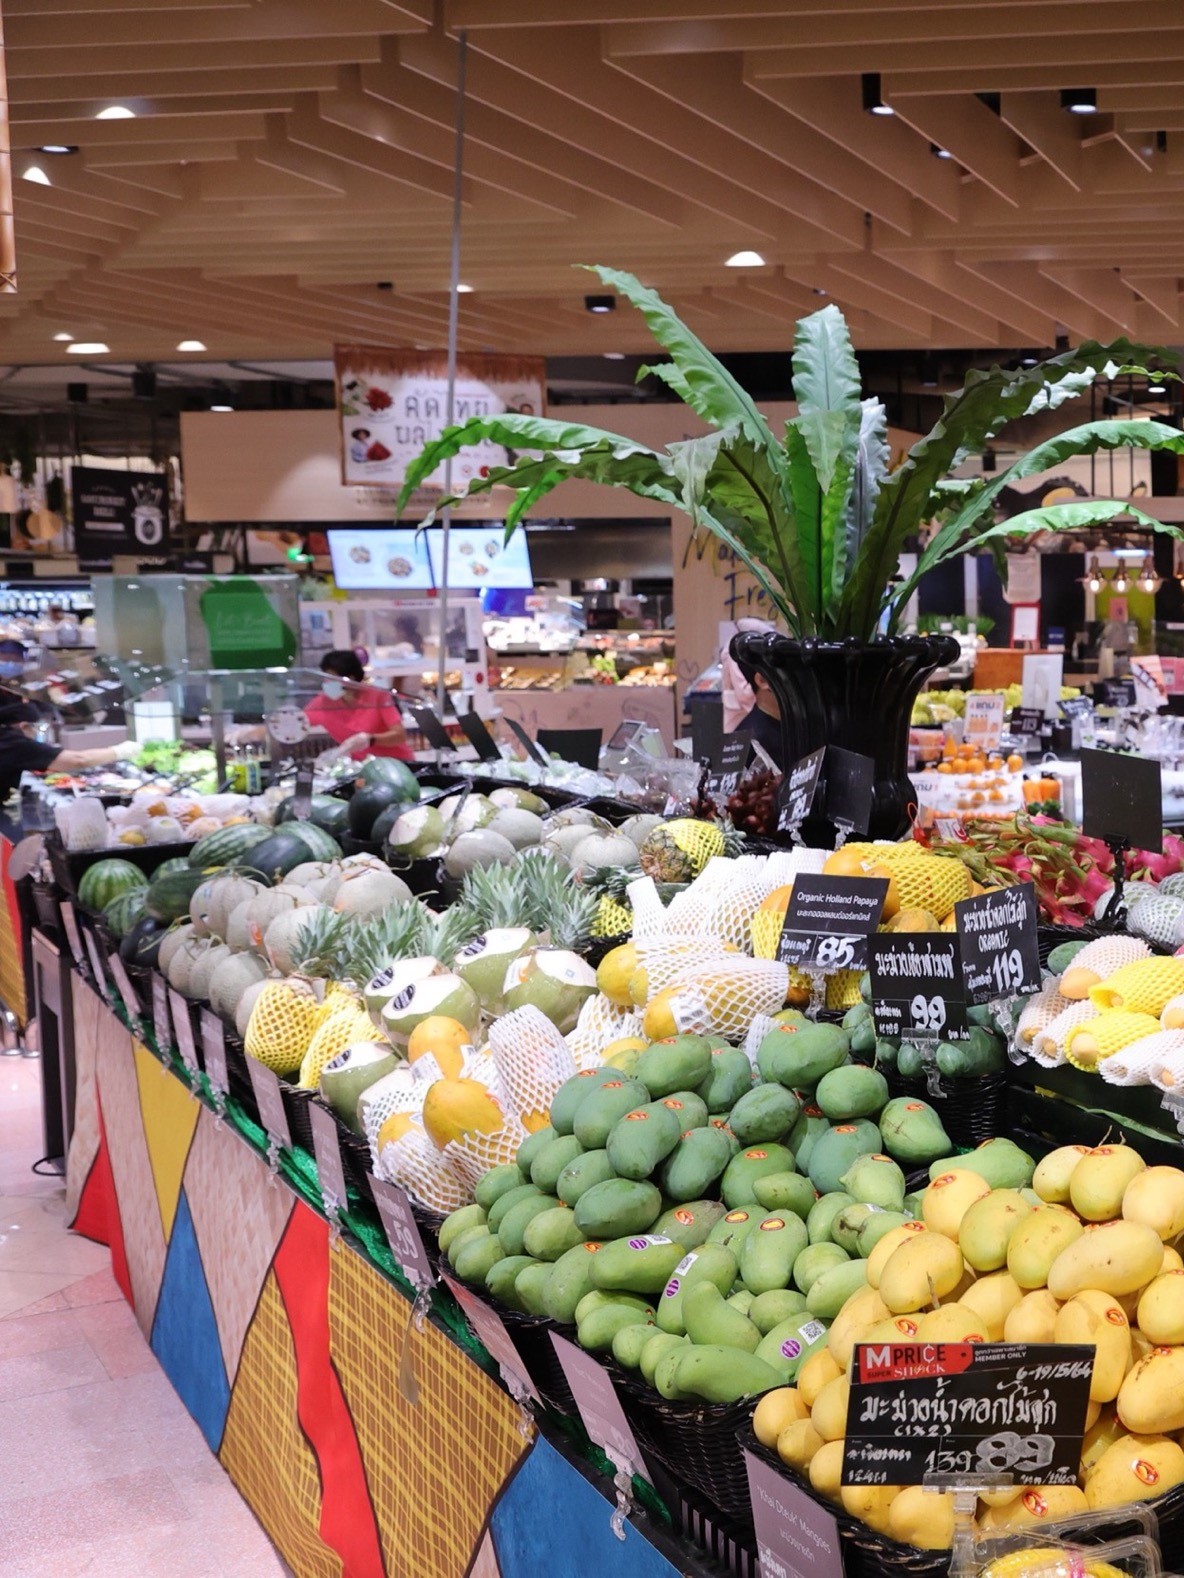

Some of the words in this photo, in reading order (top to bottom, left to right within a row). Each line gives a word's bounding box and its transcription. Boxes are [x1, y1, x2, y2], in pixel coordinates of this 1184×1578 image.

[797, 892, 825, 904] Organic
[825, 893, 853, 904] Holland
[853, 895, 879, 908] Papaya
[816, 936, 862, 968] 85
[992, 949, 1024, 993] 119
[911, 994, 947, 1031] 99
[974, 1353, 1005, 1363] MEMBER
[1006, 1350, 1028, 1360] ONLY
[867, 1370, 893, 1380] SUPER
[1016, 1360, 1092, 1380] 6-19/5/64
[975, 1430, 1056, 1474] 89
